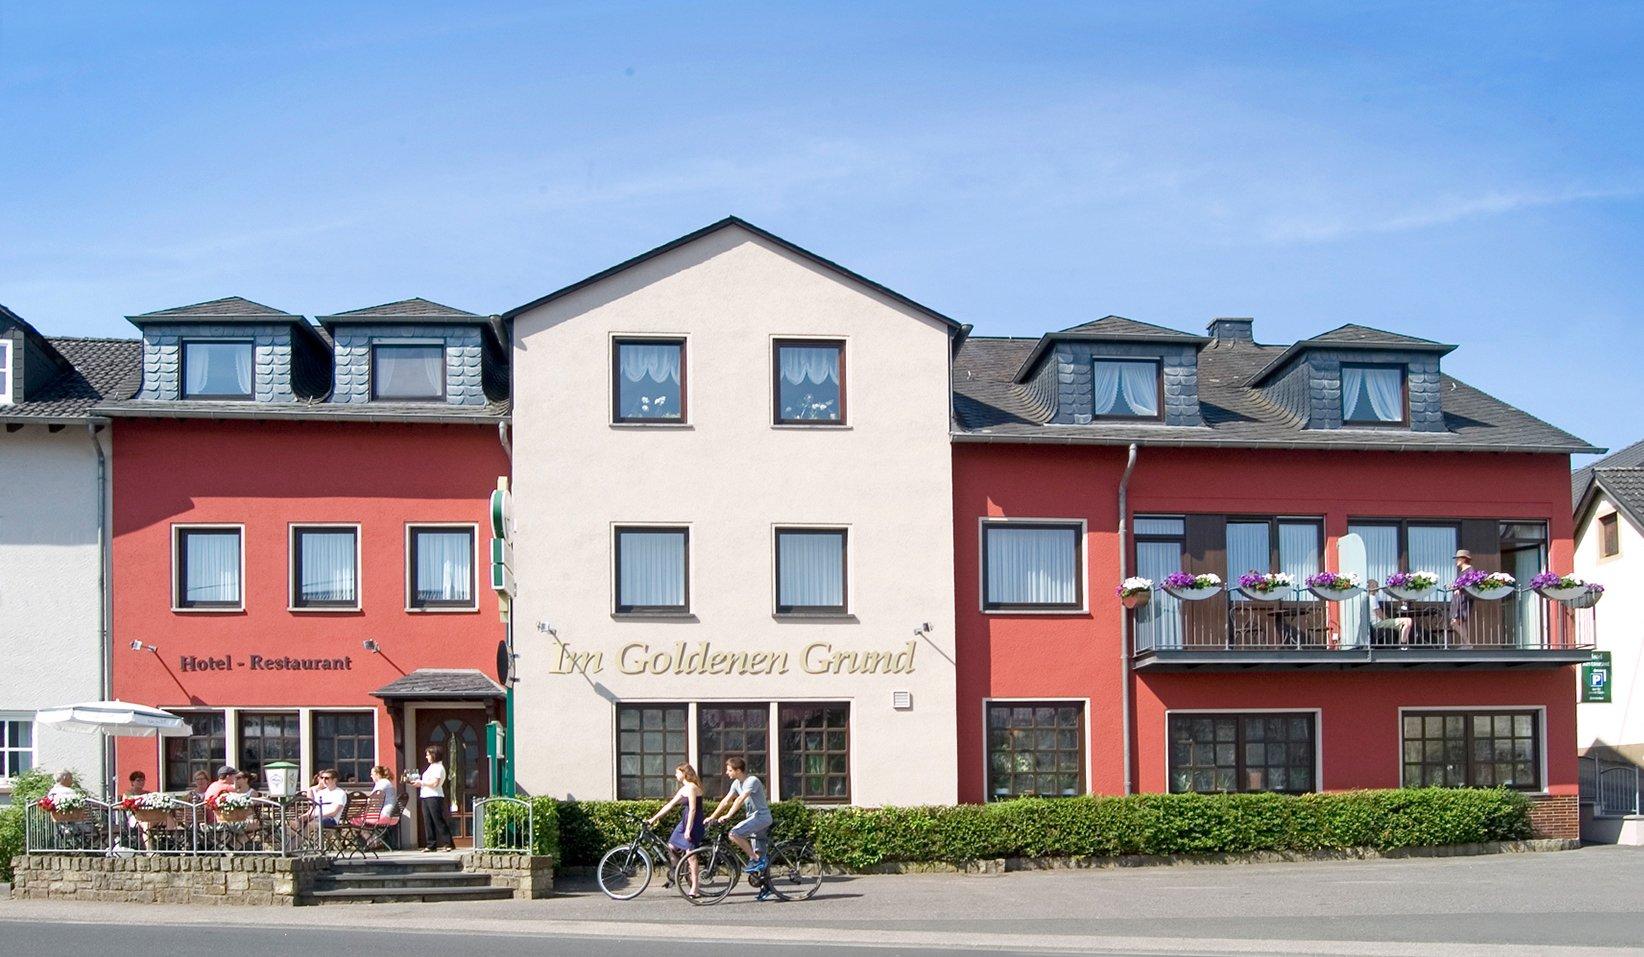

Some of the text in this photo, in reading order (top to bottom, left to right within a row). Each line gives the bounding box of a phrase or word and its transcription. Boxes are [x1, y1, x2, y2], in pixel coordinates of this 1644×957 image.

[180, 655, 232, 672] Hotel
[250, 655, 352, 670] Restaurant
[549, 640, 917, 675] Im Goldenen Grund
[1592, 674, 1601, 685] P
